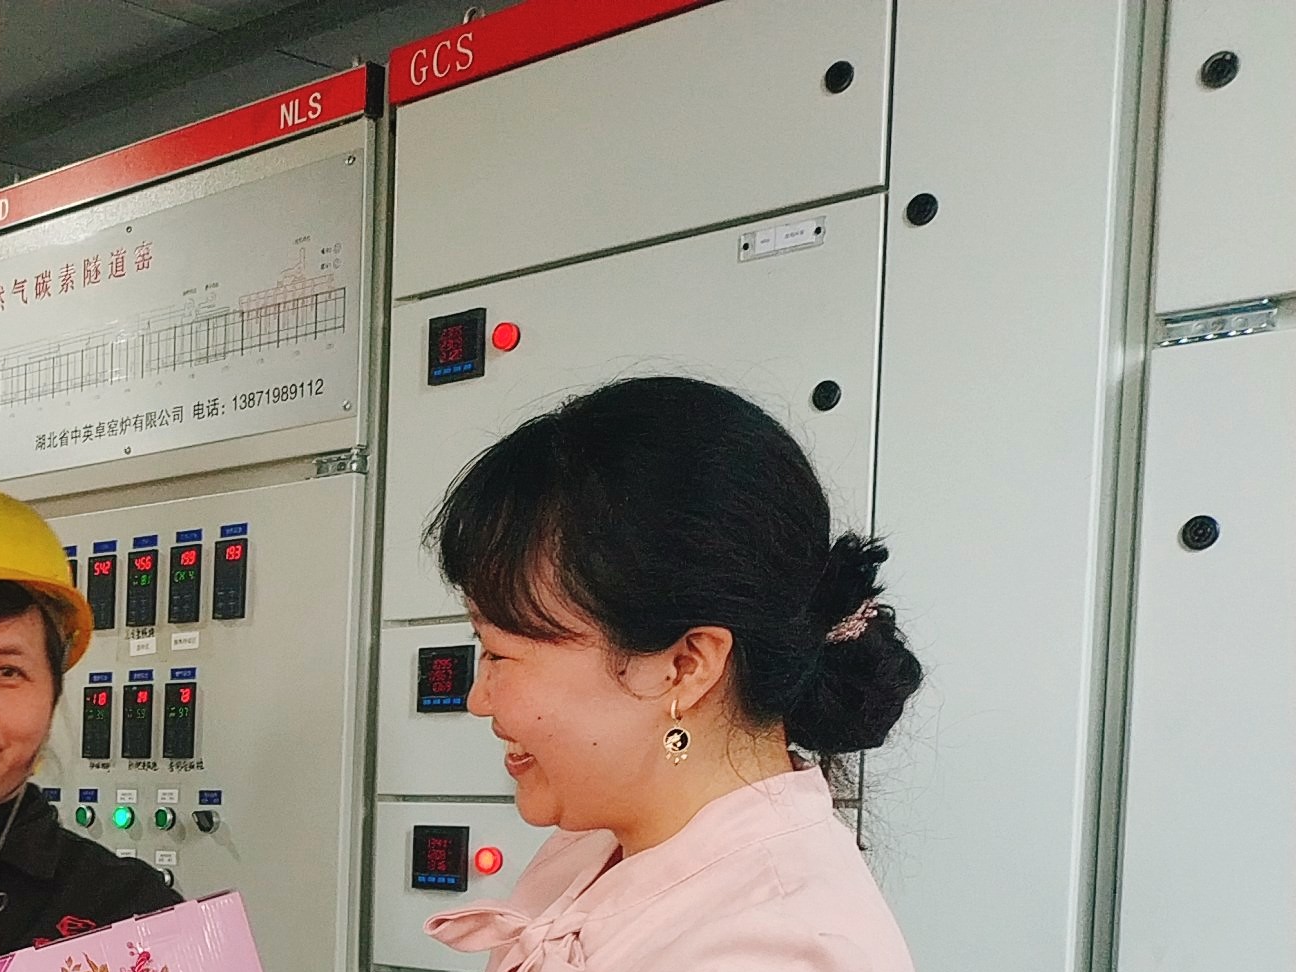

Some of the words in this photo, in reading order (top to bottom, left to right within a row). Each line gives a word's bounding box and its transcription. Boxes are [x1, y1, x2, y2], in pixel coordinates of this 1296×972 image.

[410, 32, 473, 86] GCS
[279, 92, 322, 130] NLS
[232, 378, 324, 412] 13871989112
